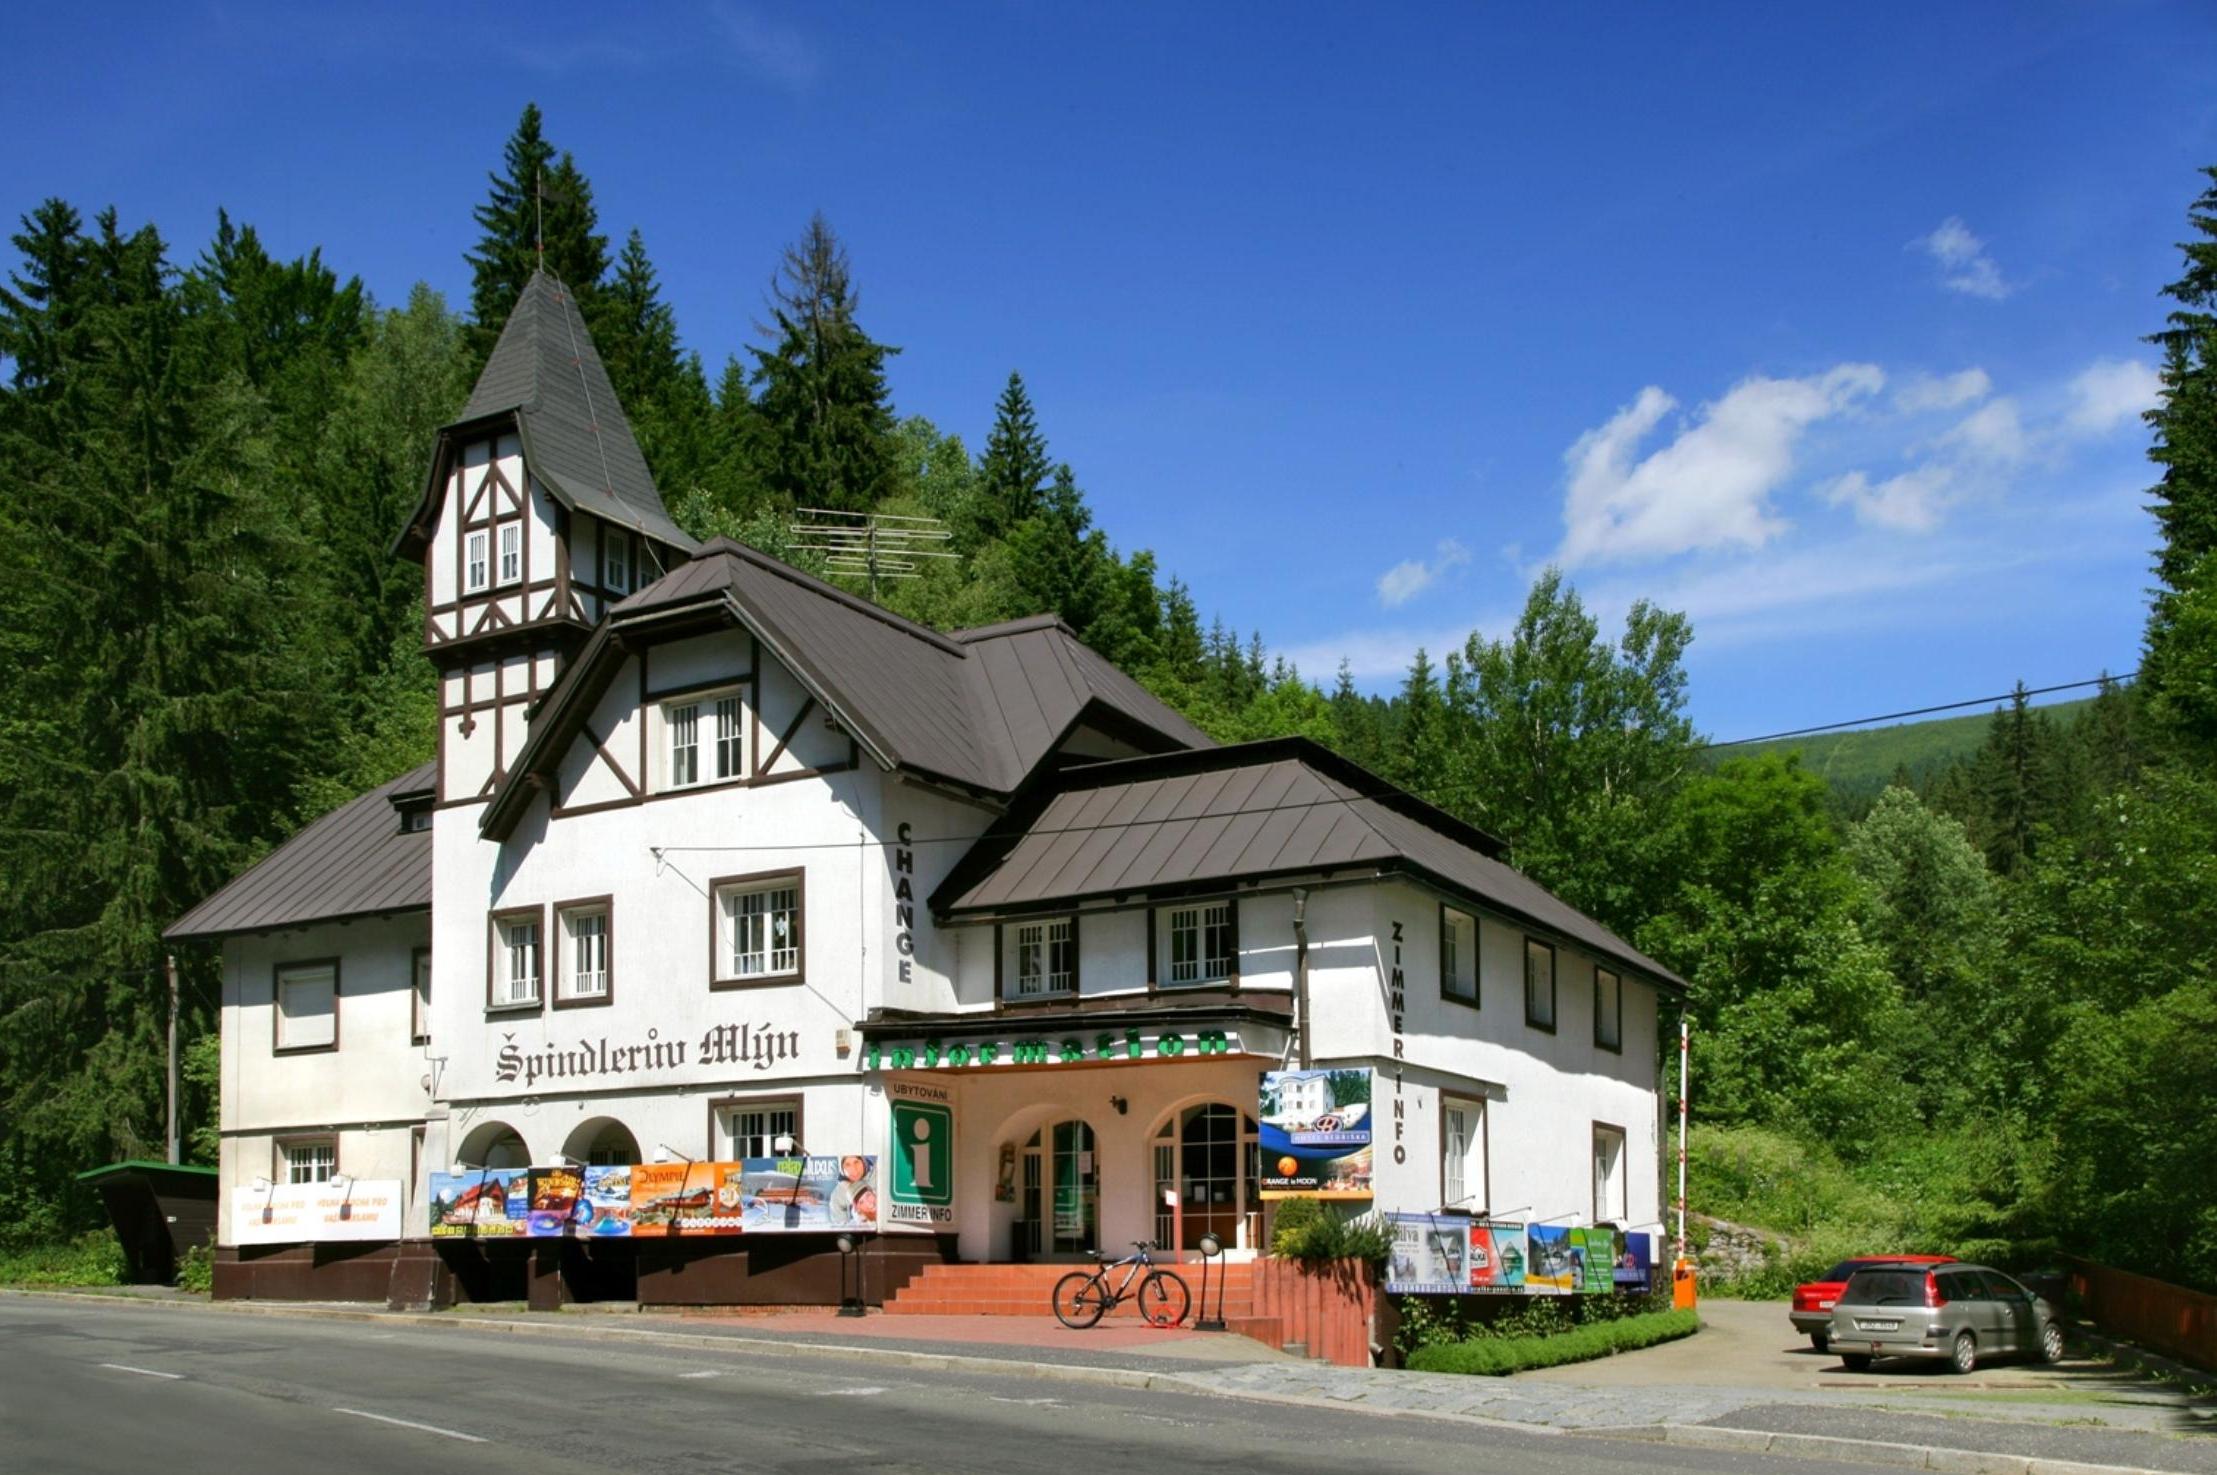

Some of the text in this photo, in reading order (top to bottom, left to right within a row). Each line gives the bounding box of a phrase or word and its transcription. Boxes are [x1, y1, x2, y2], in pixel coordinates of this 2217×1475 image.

[896, 822, 914, 984] CHANGE
[496, 1022, 799, 1088] Špindlerův Mlýn
[1391, 921, 1406, 1165] ZIMMER INFO
[891, 1205, 951, 1222] ZIMMER INFO
